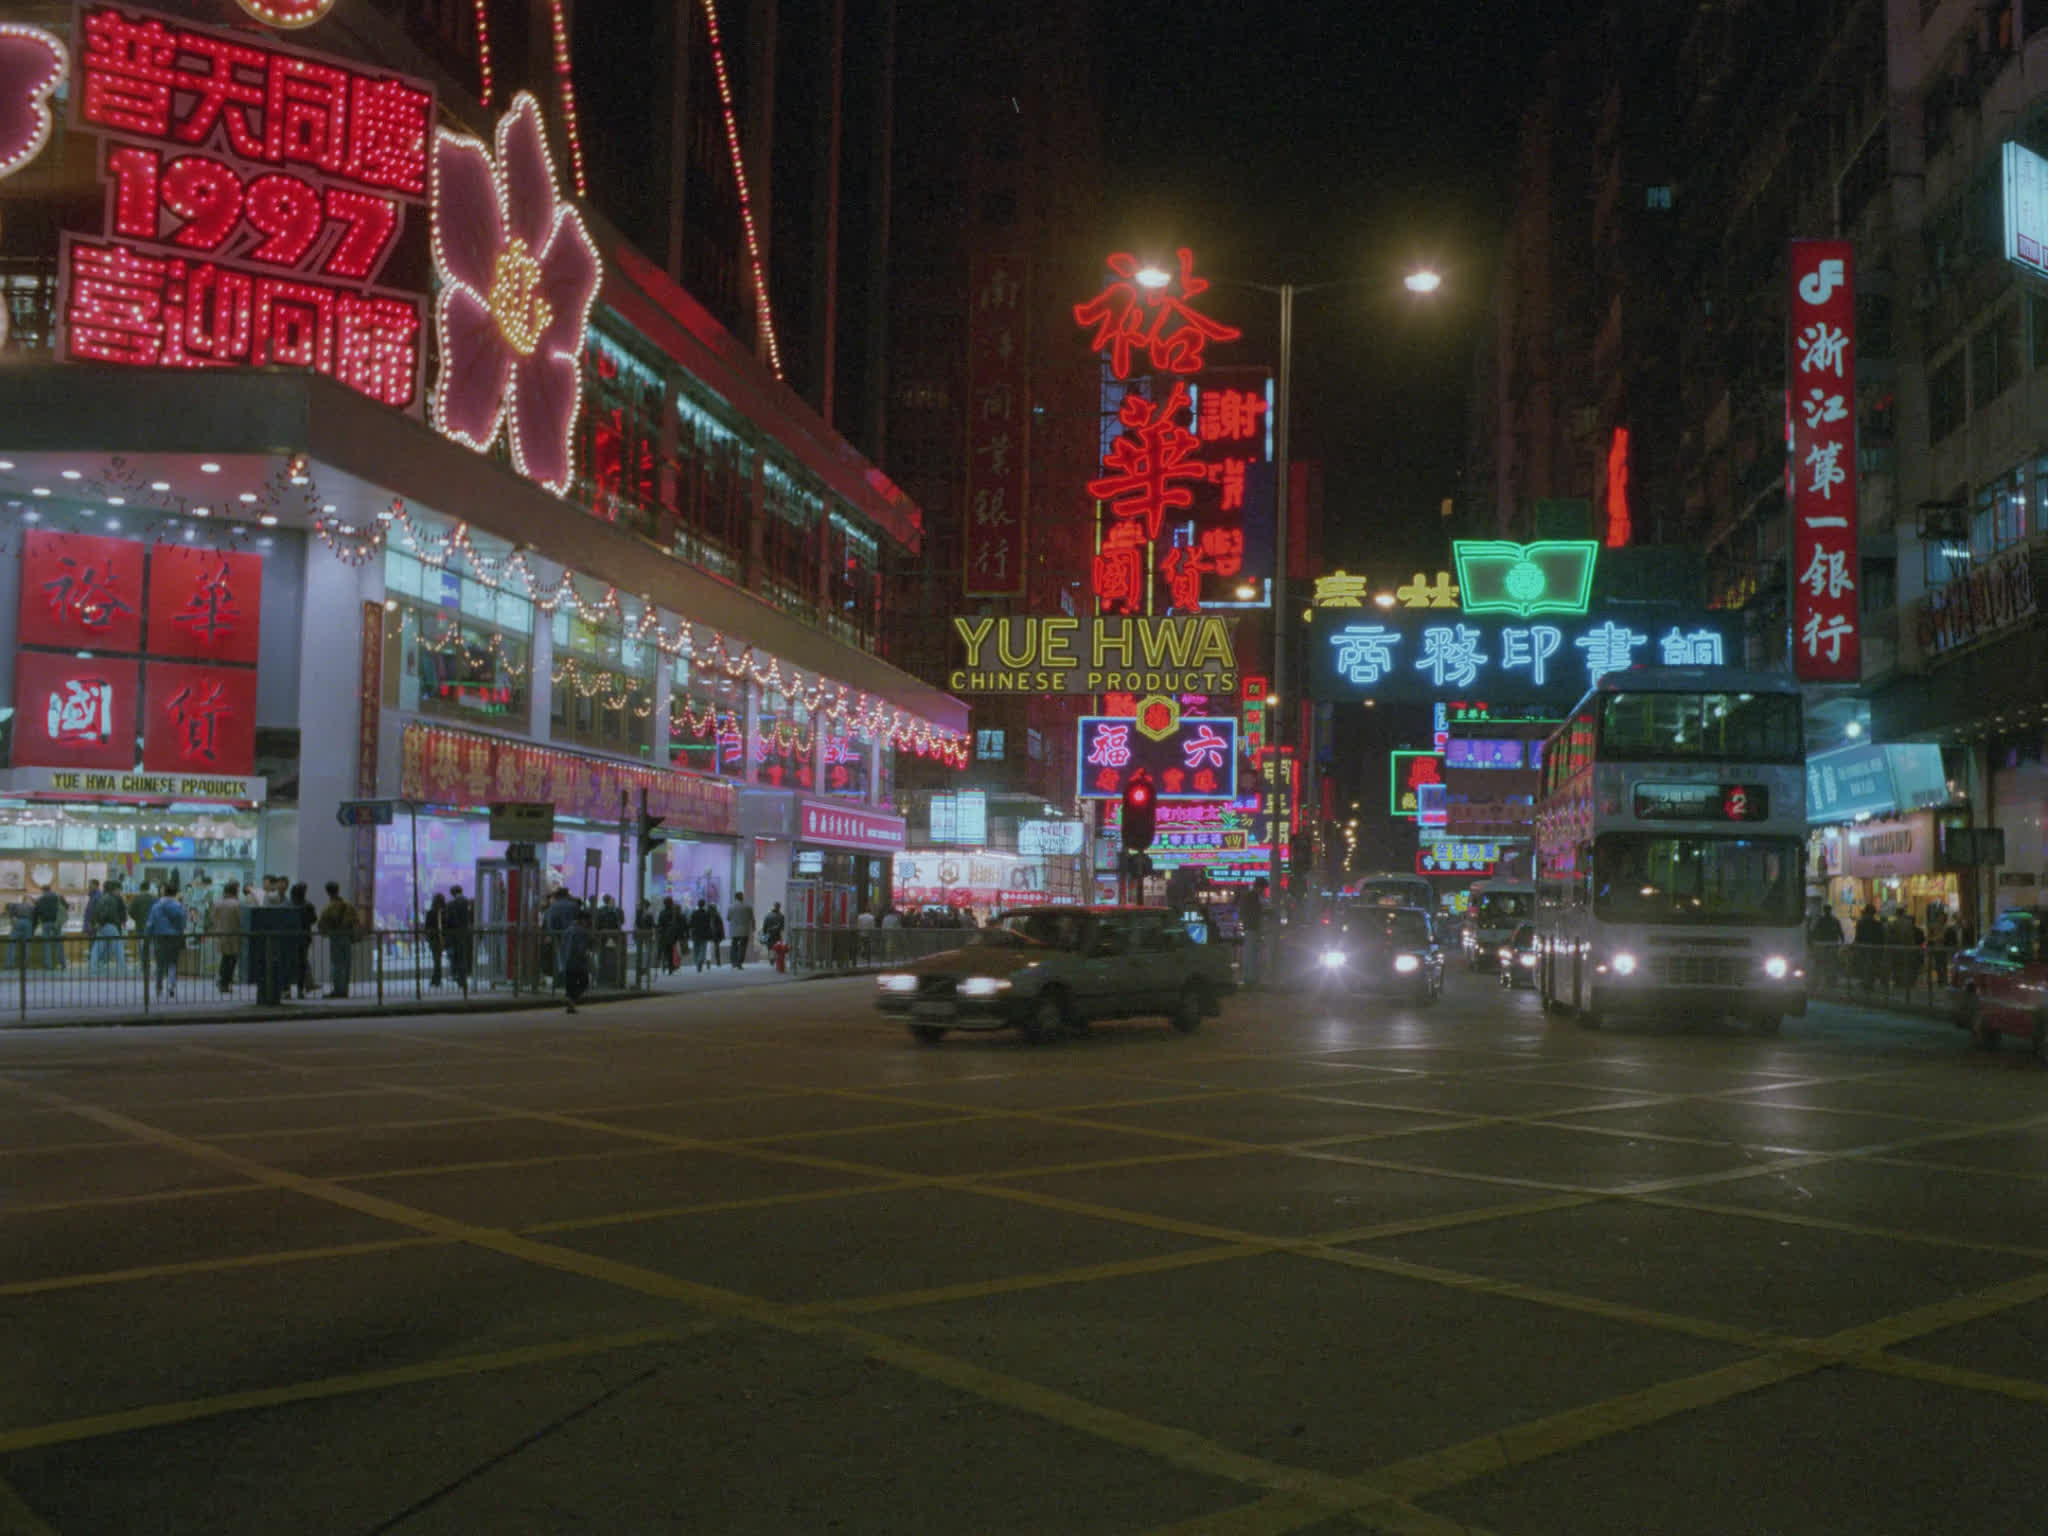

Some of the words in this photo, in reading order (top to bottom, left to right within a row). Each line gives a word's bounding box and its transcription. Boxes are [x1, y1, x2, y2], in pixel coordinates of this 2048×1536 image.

[83, 11, 431, 194] 普天同慶
[109, 148, 396, 278] 1997
[1074, 248, 1240, 540] 裕華
[1798, 321, 1854, 663] 浙江第一銀行
[951, 671, 1066, 691] CHINESE
[1087, 671, 1235, 692] PRODUCTS
[953, 617, 1079, 669] YUE
[1093, 617, 1236, 669] HWA
[53, 772, 80, 788] YUE
[86, 775, 116, 791] HWA
[121, 775, 176, 793] CHINESE
